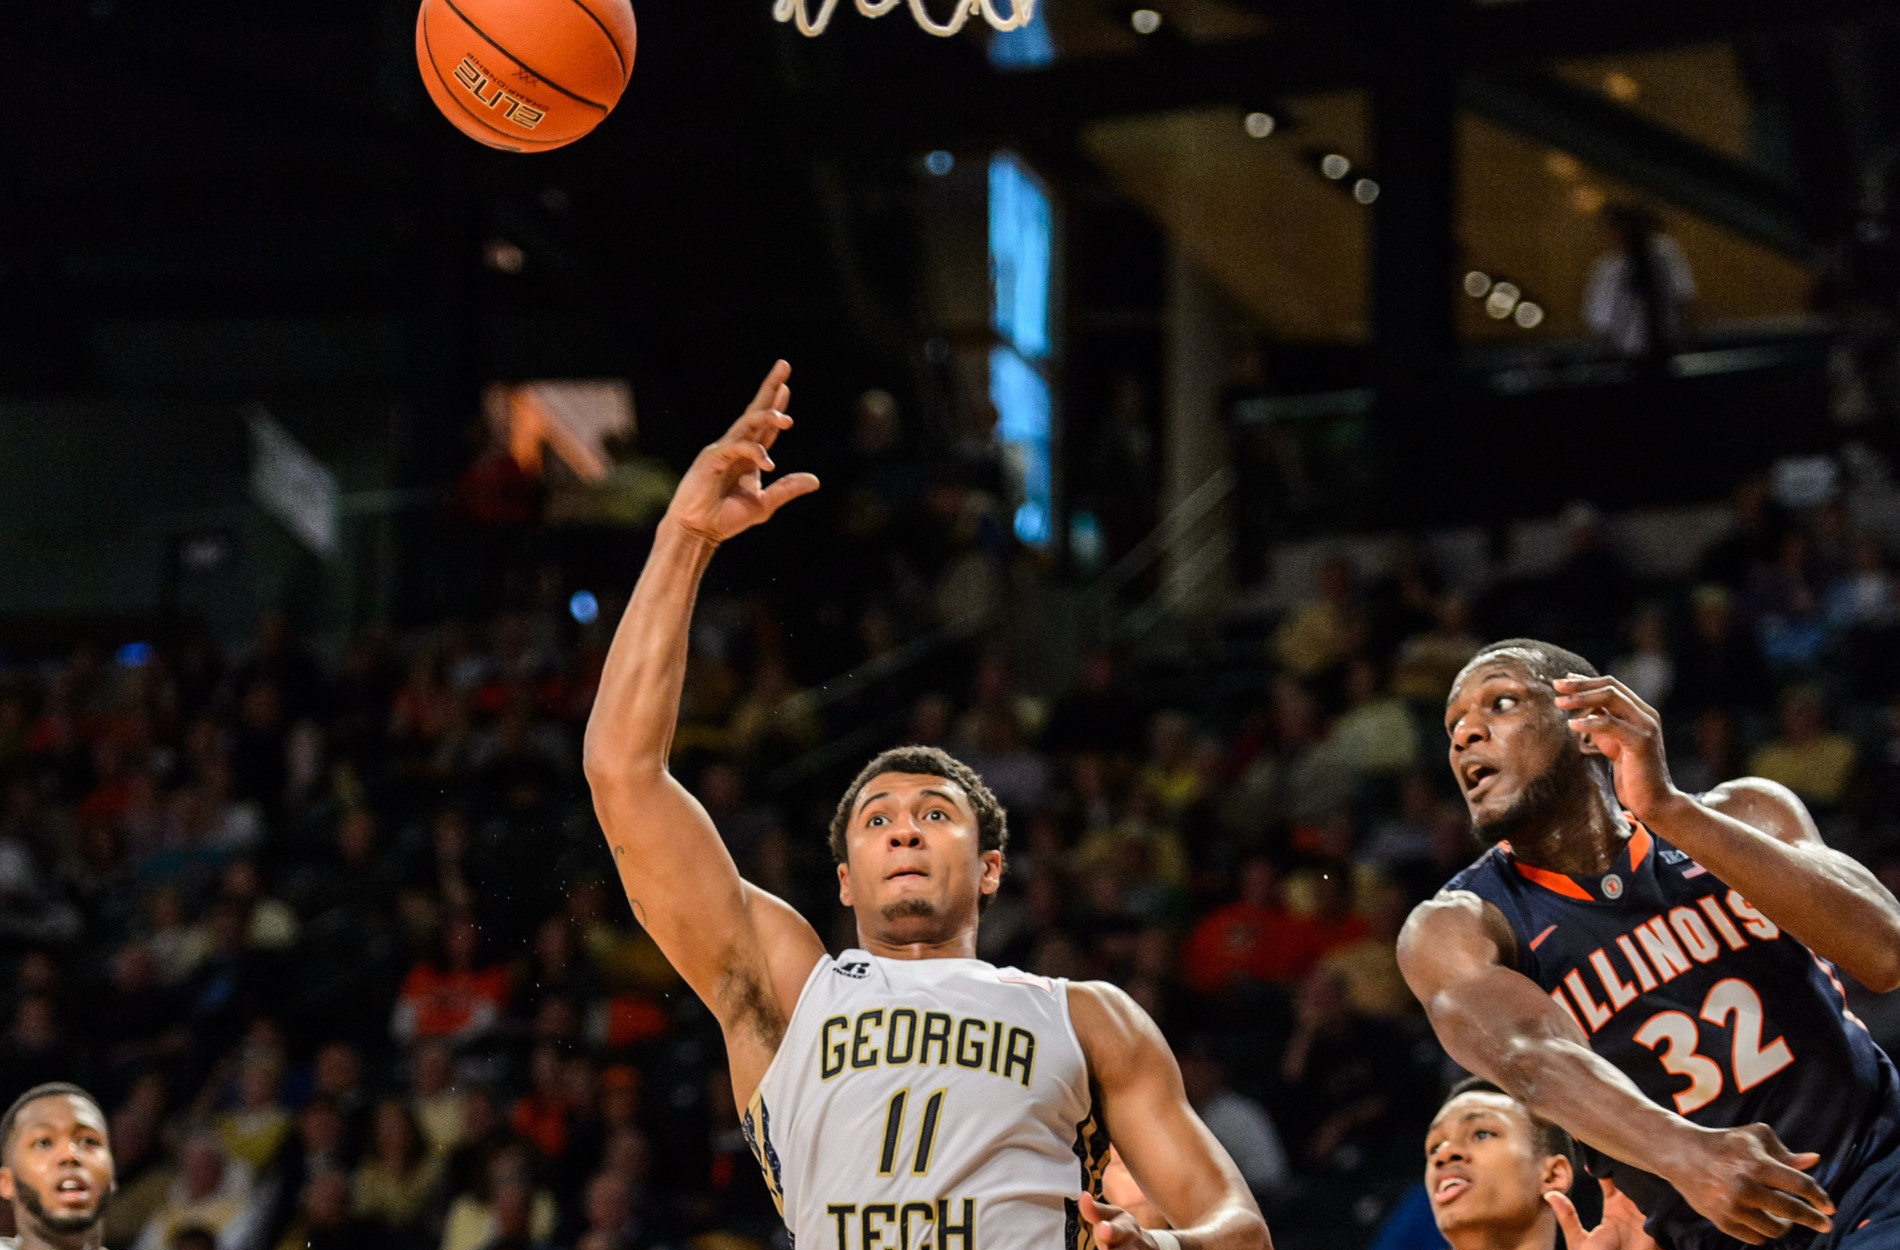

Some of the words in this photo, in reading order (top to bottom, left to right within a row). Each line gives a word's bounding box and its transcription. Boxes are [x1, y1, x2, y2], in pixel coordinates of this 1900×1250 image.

[453, 57, 547, 131] ELITE
[819, 1007, 1037, 1090] GEORGIA
[1632, 977, 1795, 1116] 32
[876, 1086, 949, 1177] 11
